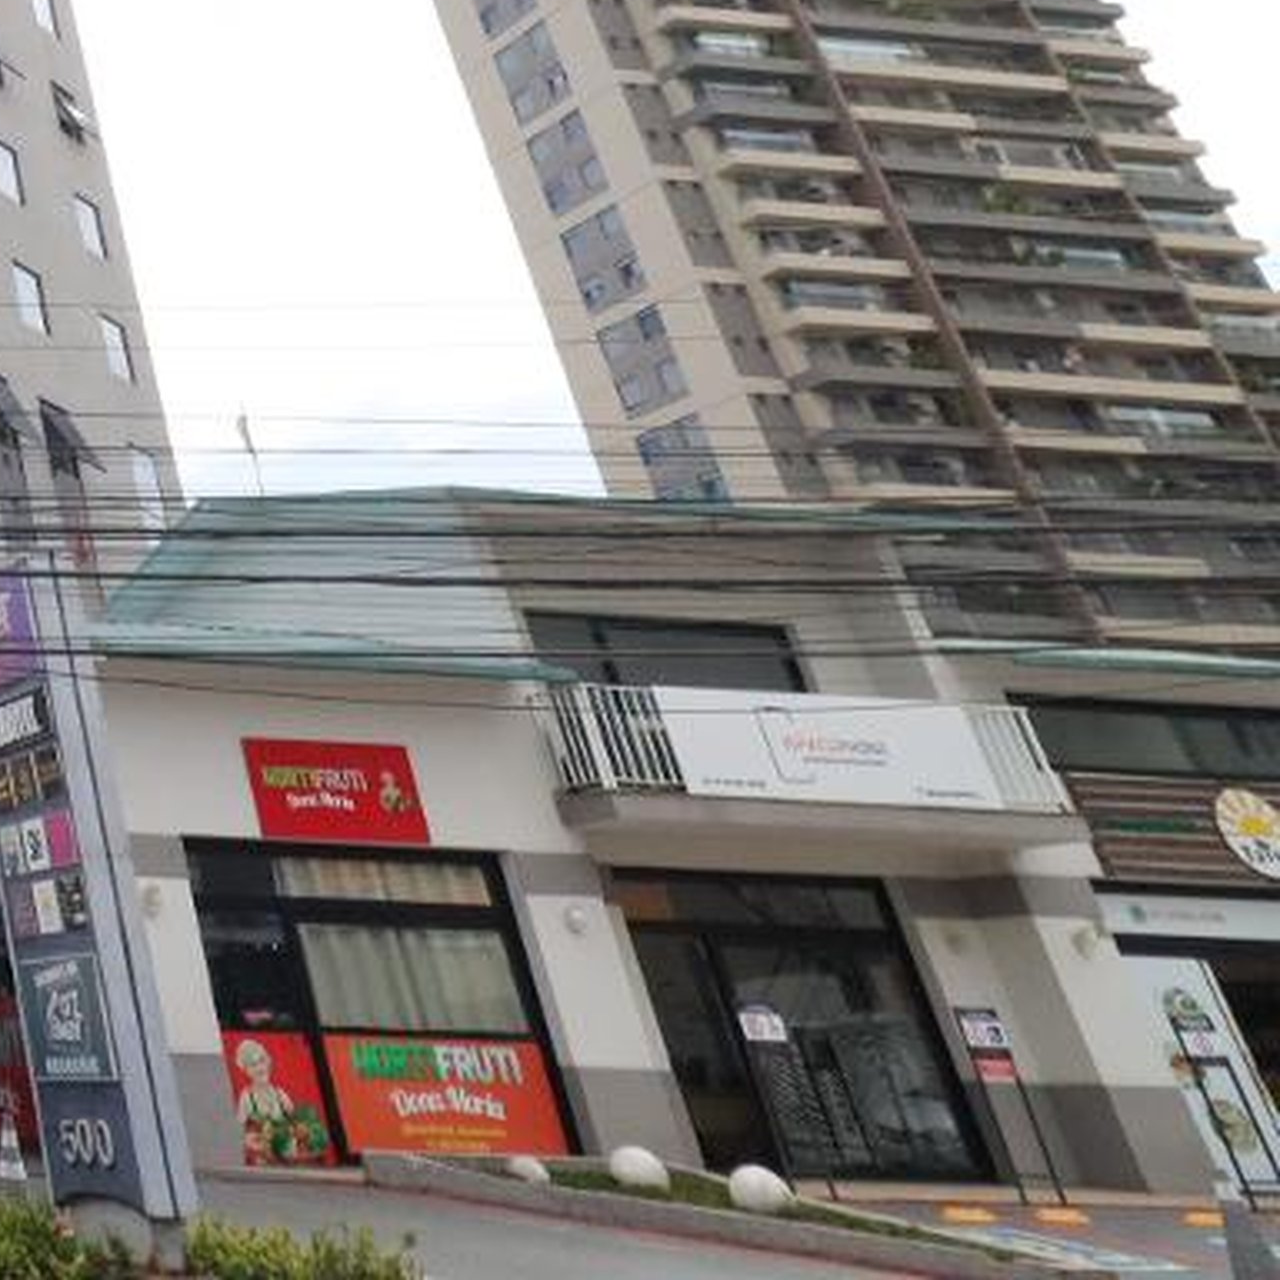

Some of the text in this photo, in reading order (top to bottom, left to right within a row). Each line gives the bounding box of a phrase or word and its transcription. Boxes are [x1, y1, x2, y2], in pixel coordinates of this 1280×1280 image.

[352, 1042, 524, 1086] HORTIFRUTI
[391, 1085, 507, 1121] Dona Maria
[59, 1119, 115, 1167] 500
